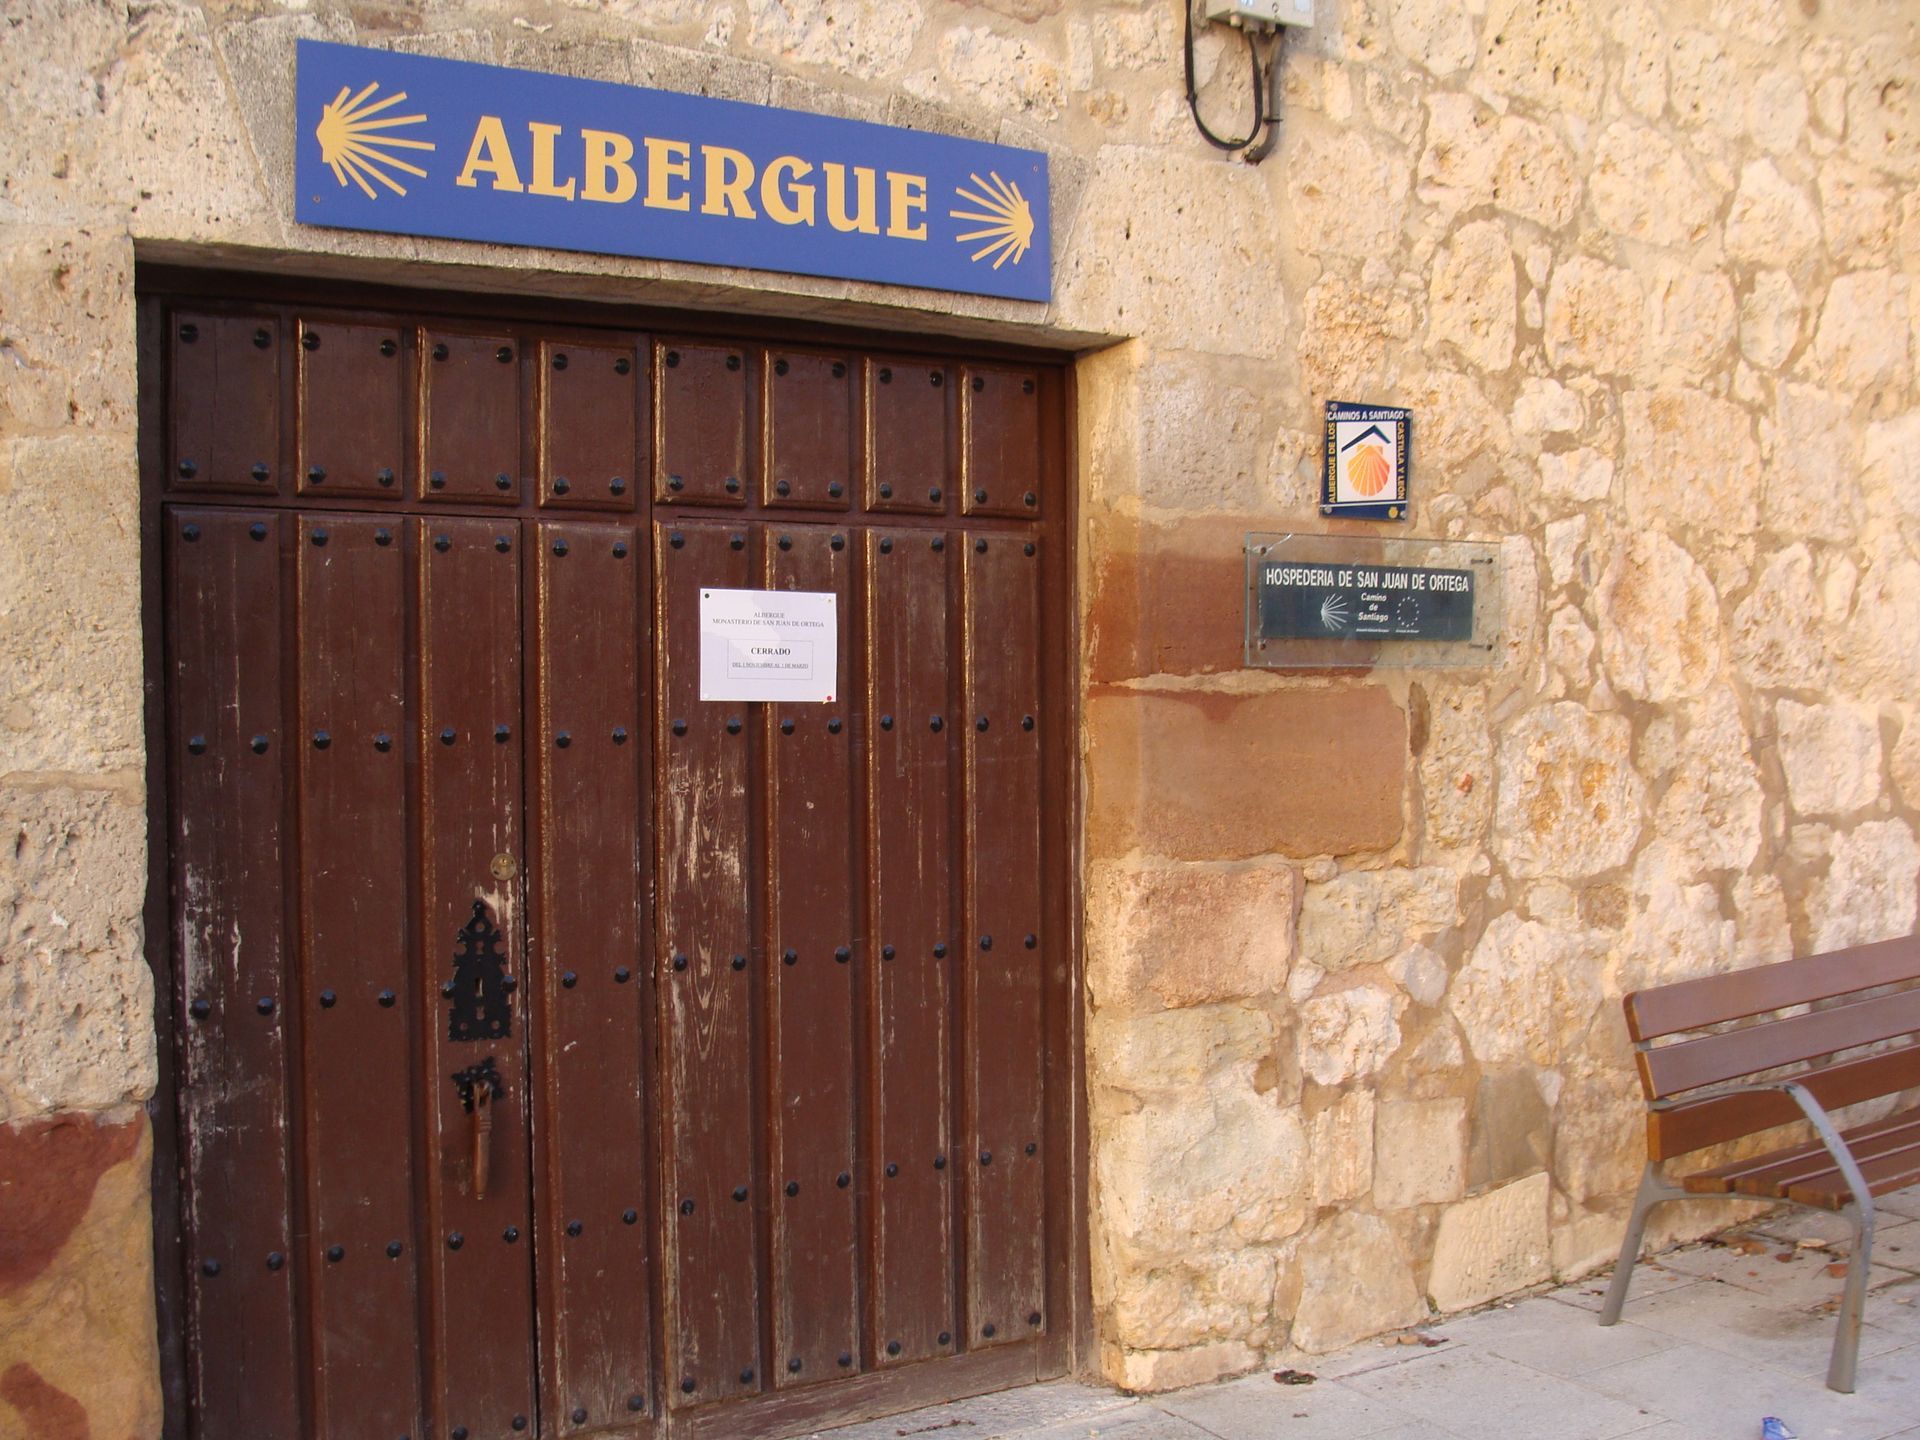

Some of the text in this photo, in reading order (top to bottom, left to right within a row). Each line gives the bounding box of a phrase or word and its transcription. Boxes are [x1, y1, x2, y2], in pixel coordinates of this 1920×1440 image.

[456, 115, 928, 241] ALBERGUE
[1327, 410, 1404, 421] CAMINOS A SANTIAGO
[1328, 422, 1336, 503] ALBERGUE DE LOS
[1266, 568, 1469, 592] HOSPEDERIA DE SAN JUAN DE ORTEGA
[1361, 592, 1387, 602] Camino
[1369, 603, 1378, 611] de
[1358, 612, 1389, 622] Santiago
[751, 647, 791, 656] CERRADO
